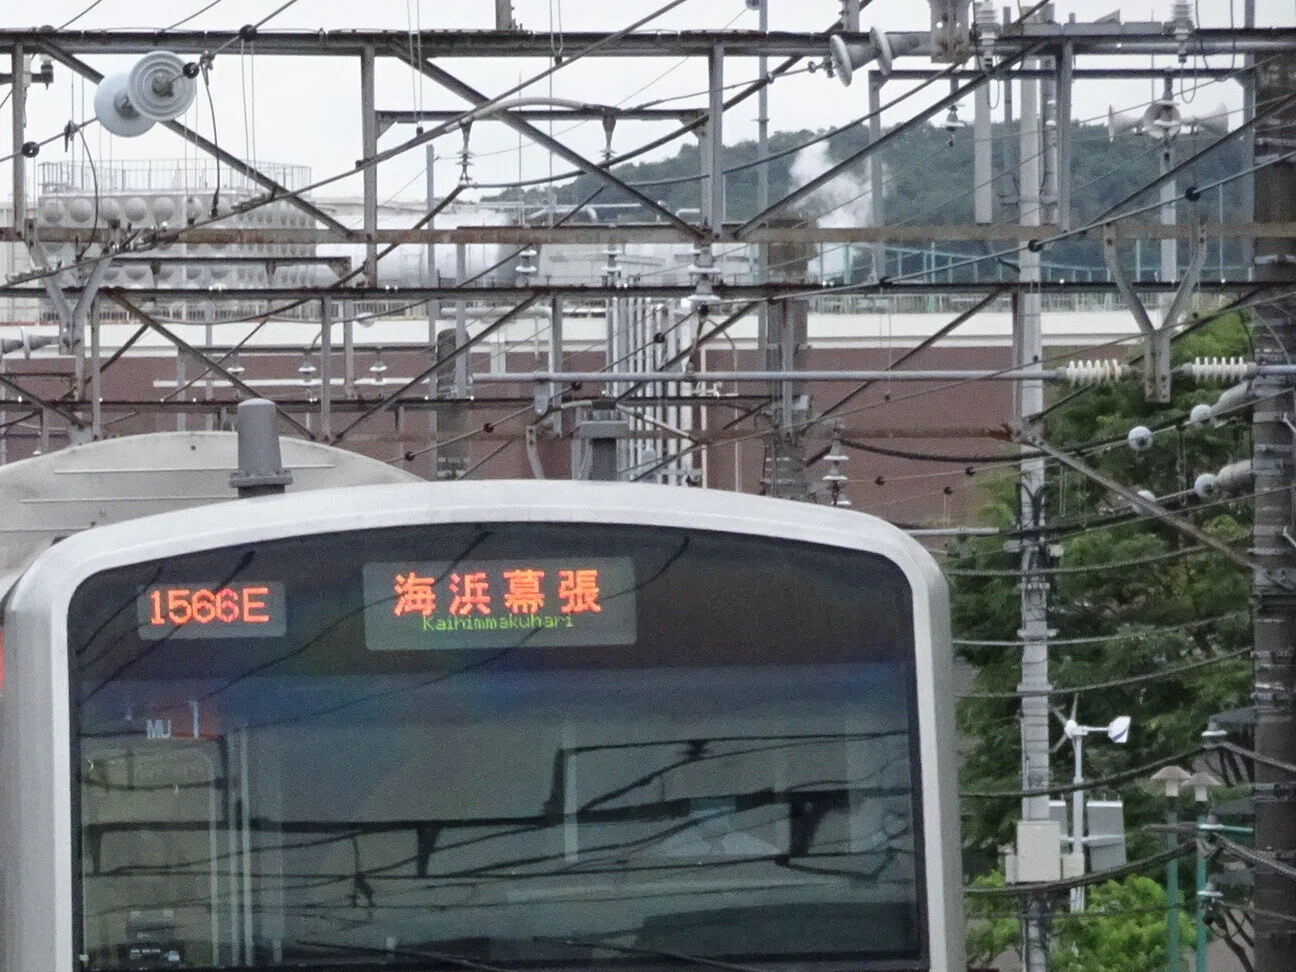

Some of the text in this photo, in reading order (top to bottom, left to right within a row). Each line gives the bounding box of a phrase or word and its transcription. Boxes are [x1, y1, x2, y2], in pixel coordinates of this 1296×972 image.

[150, 587, 271, 625] 1566E
[393, 569, 602, 617] 海浜幕張
